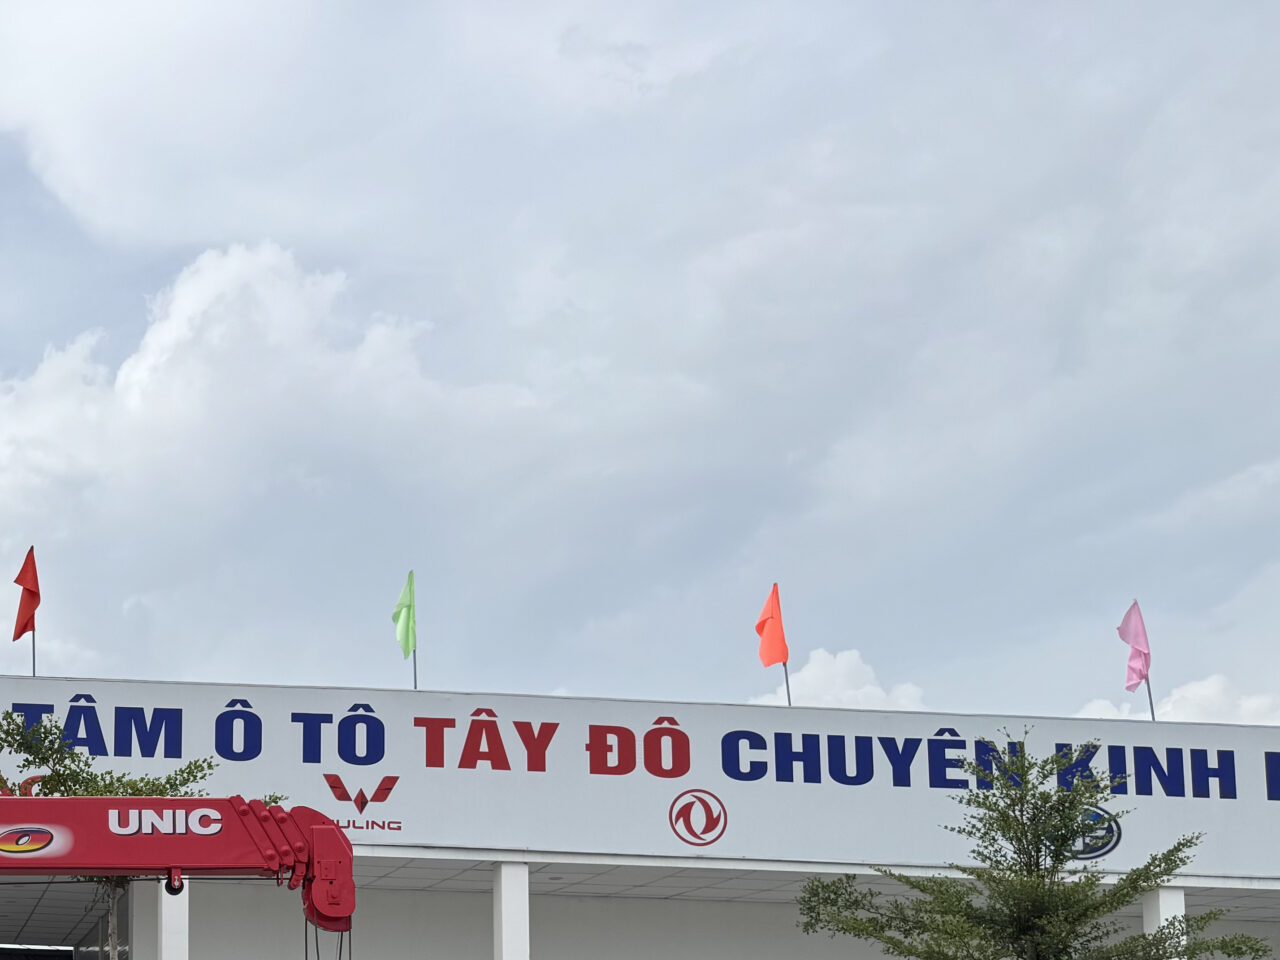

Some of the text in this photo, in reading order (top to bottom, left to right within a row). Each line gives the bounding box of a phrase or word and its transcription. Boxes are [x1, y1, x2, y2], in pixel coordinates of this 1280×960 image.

[11, 694, 183, 759] TÂM
[215, 699, 263, 762] Ô
[291, 703, 386, 766] TÔ
[413, 707, 560, 773] TÂY
[585, 716, 691, 779] ĐÔ
[721, 727, 1024, 790] CHUYÊN
[1055, 743, 1237, 799] KINH
[108, 808, 223, 836] UNIC
[331, 819, 402, 831] ULING
